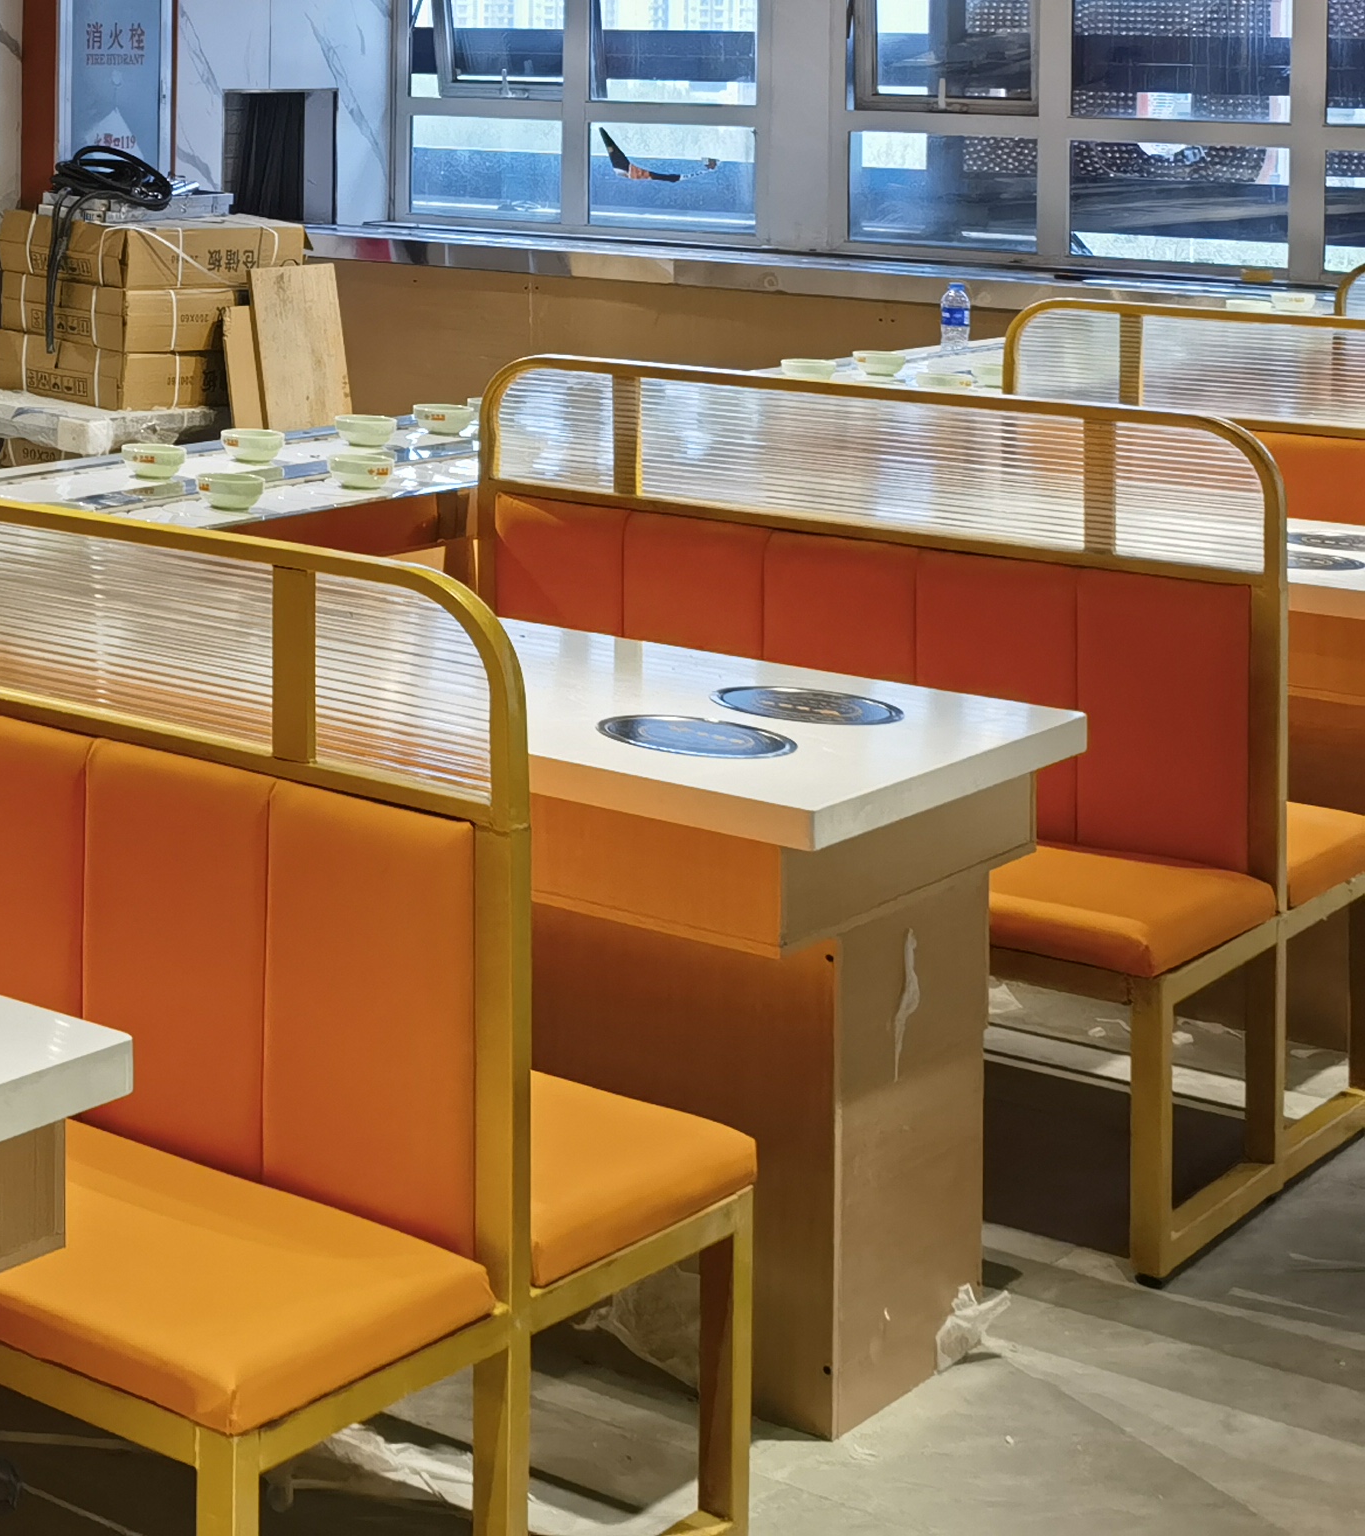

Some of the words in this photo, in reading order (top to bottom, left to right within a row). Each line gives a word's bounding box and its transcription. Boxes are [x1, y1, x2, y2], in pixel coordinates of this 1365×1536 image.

[85, 21, 146, 51] 消火栓
[85, 53, 106, 66] FIRE
[106, 53, 146, 66] HYDRANT
[120, 134, 136, 149] 119
[207, 248, 257, 273] 仓储板
[180, 312, 210, 323] 200X60
